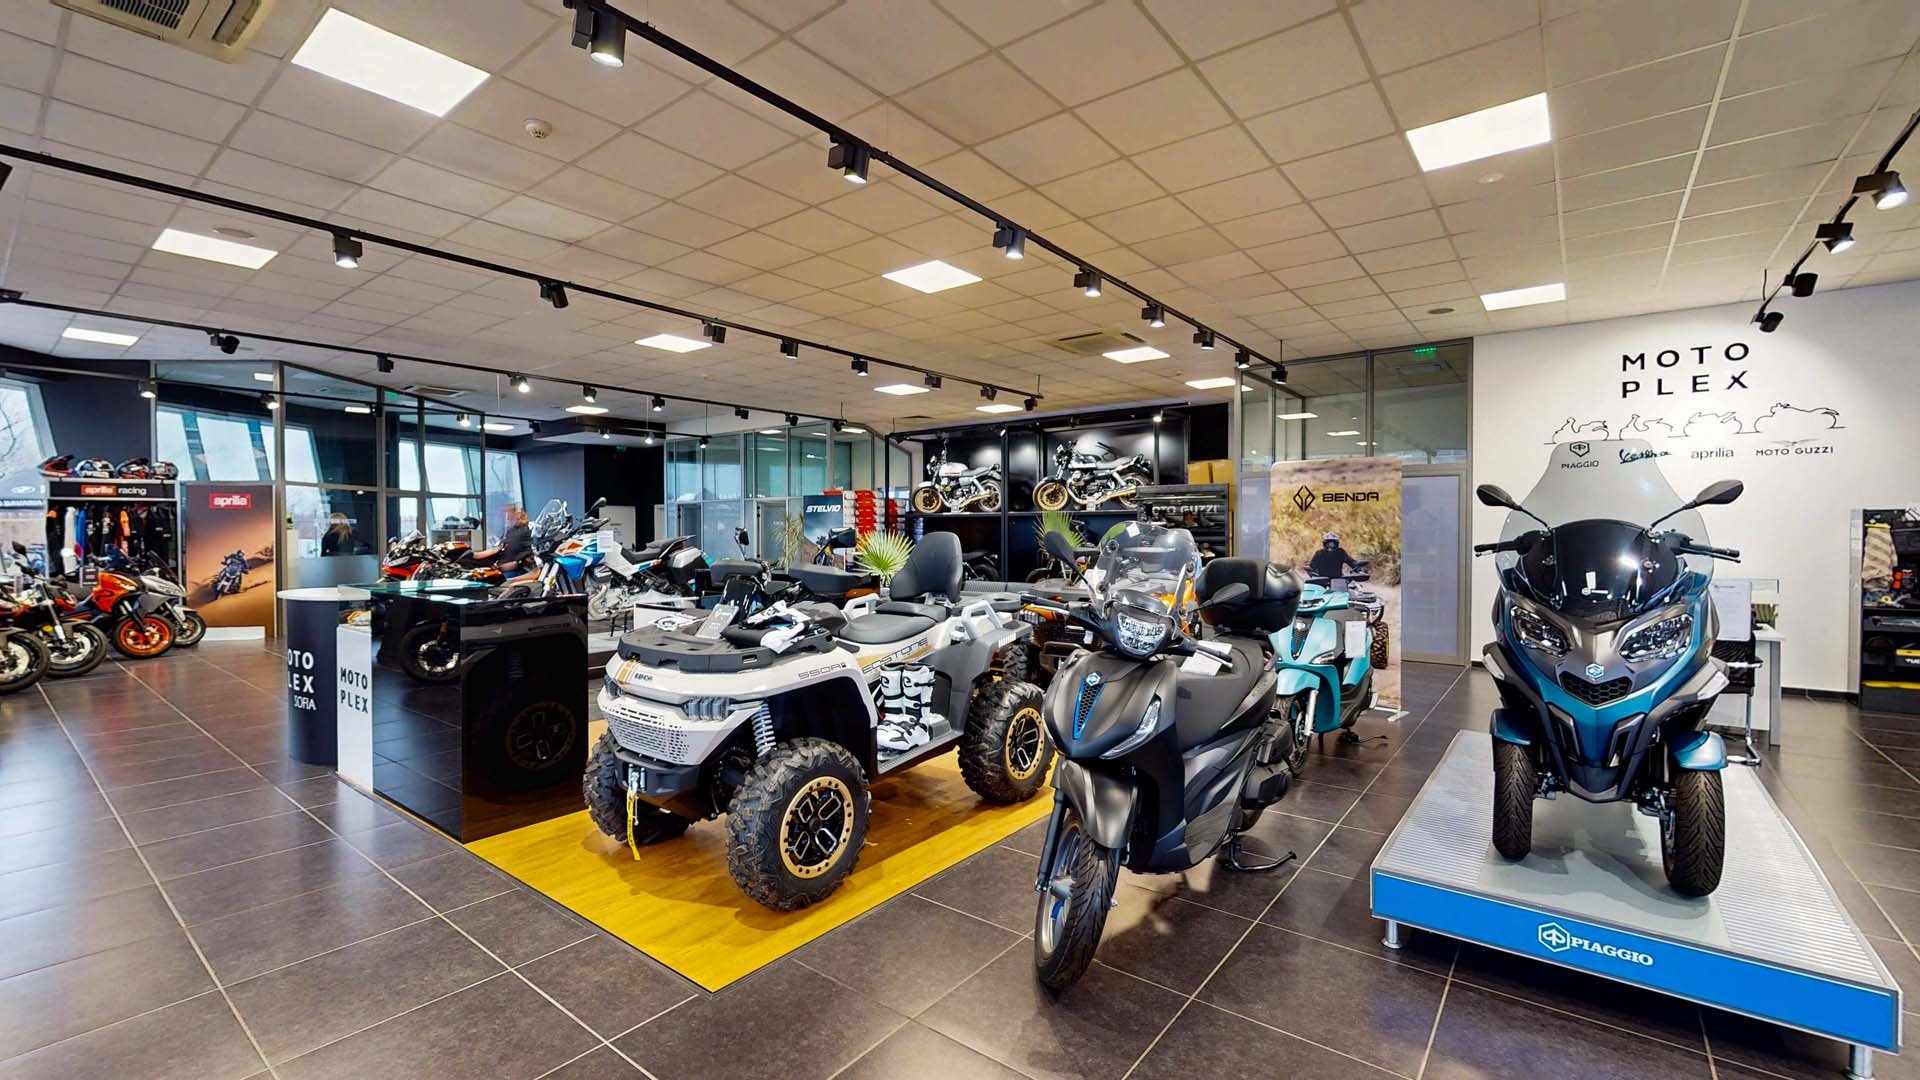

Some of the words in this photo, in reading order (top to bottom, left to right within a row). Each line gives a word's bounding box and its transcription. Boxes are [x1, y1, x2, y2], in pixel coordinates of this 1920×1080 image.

[1621, 342, 1750, 372] MOTO
[1621, 370, 1749, 399] PLEX
[1690, 447, 1734, 460] aprilia
[1755, 448, 1790, 457] MOTO
[1794, 445, 1834, 455] GUZZI
[1561, 460, 1599, 469] PIAGGIO
[118, 486, 147, 496] racing
[213, 495, 248, 507] aprilia
[1322, 491, 1379, 502] BENDA
[806, 504, 841, 513] STELVIO
[288, 648, 315, 670] OTO
[288, 671, 315, 694] LEX
[340, 667, 368, 690] MOTO
[340, 690, 368, 713] PLEX
[1571, 936, 1654, 966] PIAGGIO
